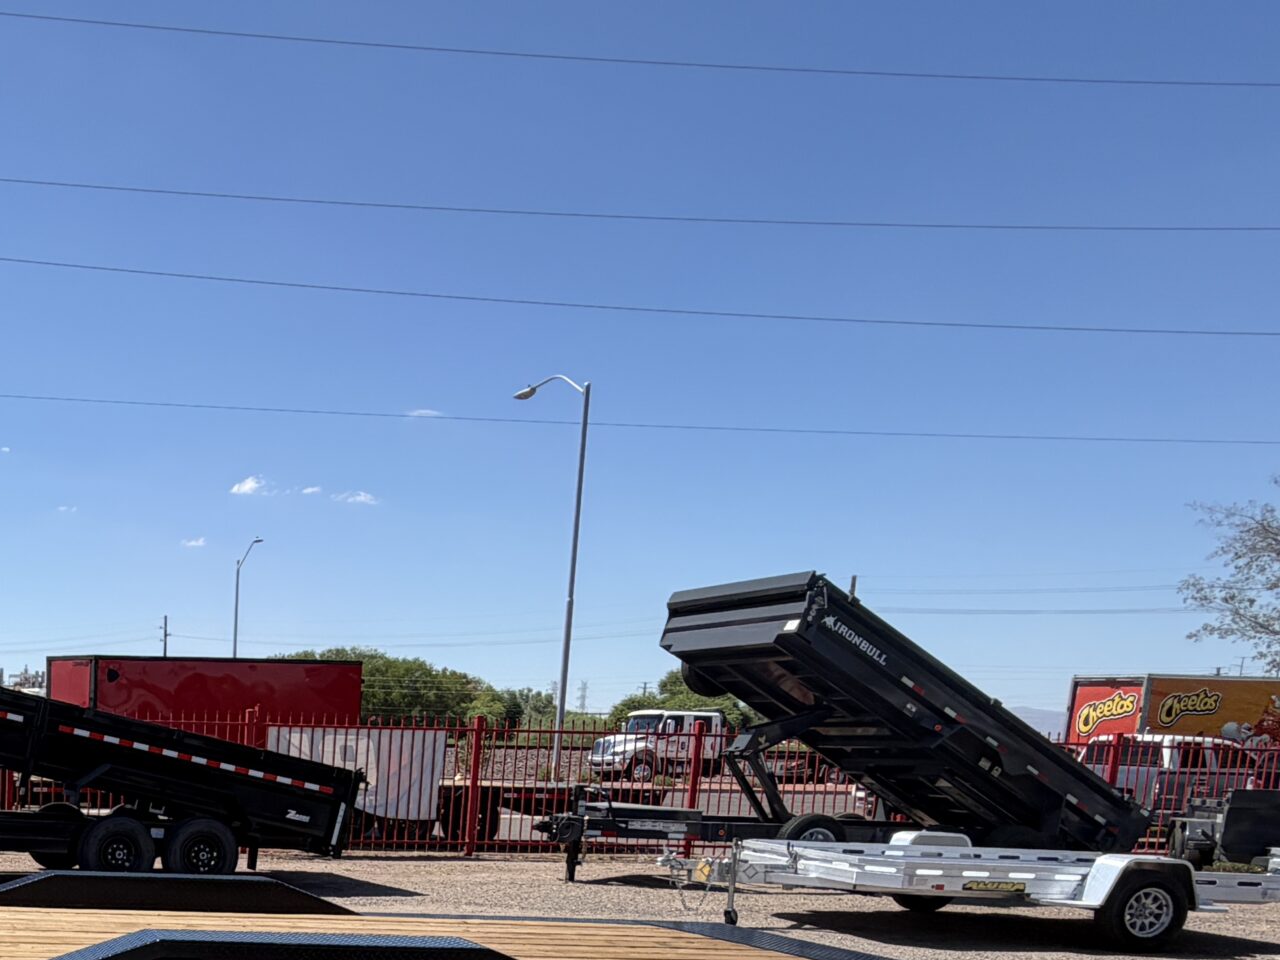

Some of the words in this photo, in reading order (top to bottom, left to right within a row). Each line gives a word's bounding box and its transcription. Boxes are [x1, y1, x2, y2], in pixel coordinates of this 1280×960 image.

[835, 622, 887, 666] IRONBULL
[1078, 692, 1137, 734] Cheetos
[1160, 691, 1218, 725] Cheetos
[964, 881, 1025, 892] ALUMA
